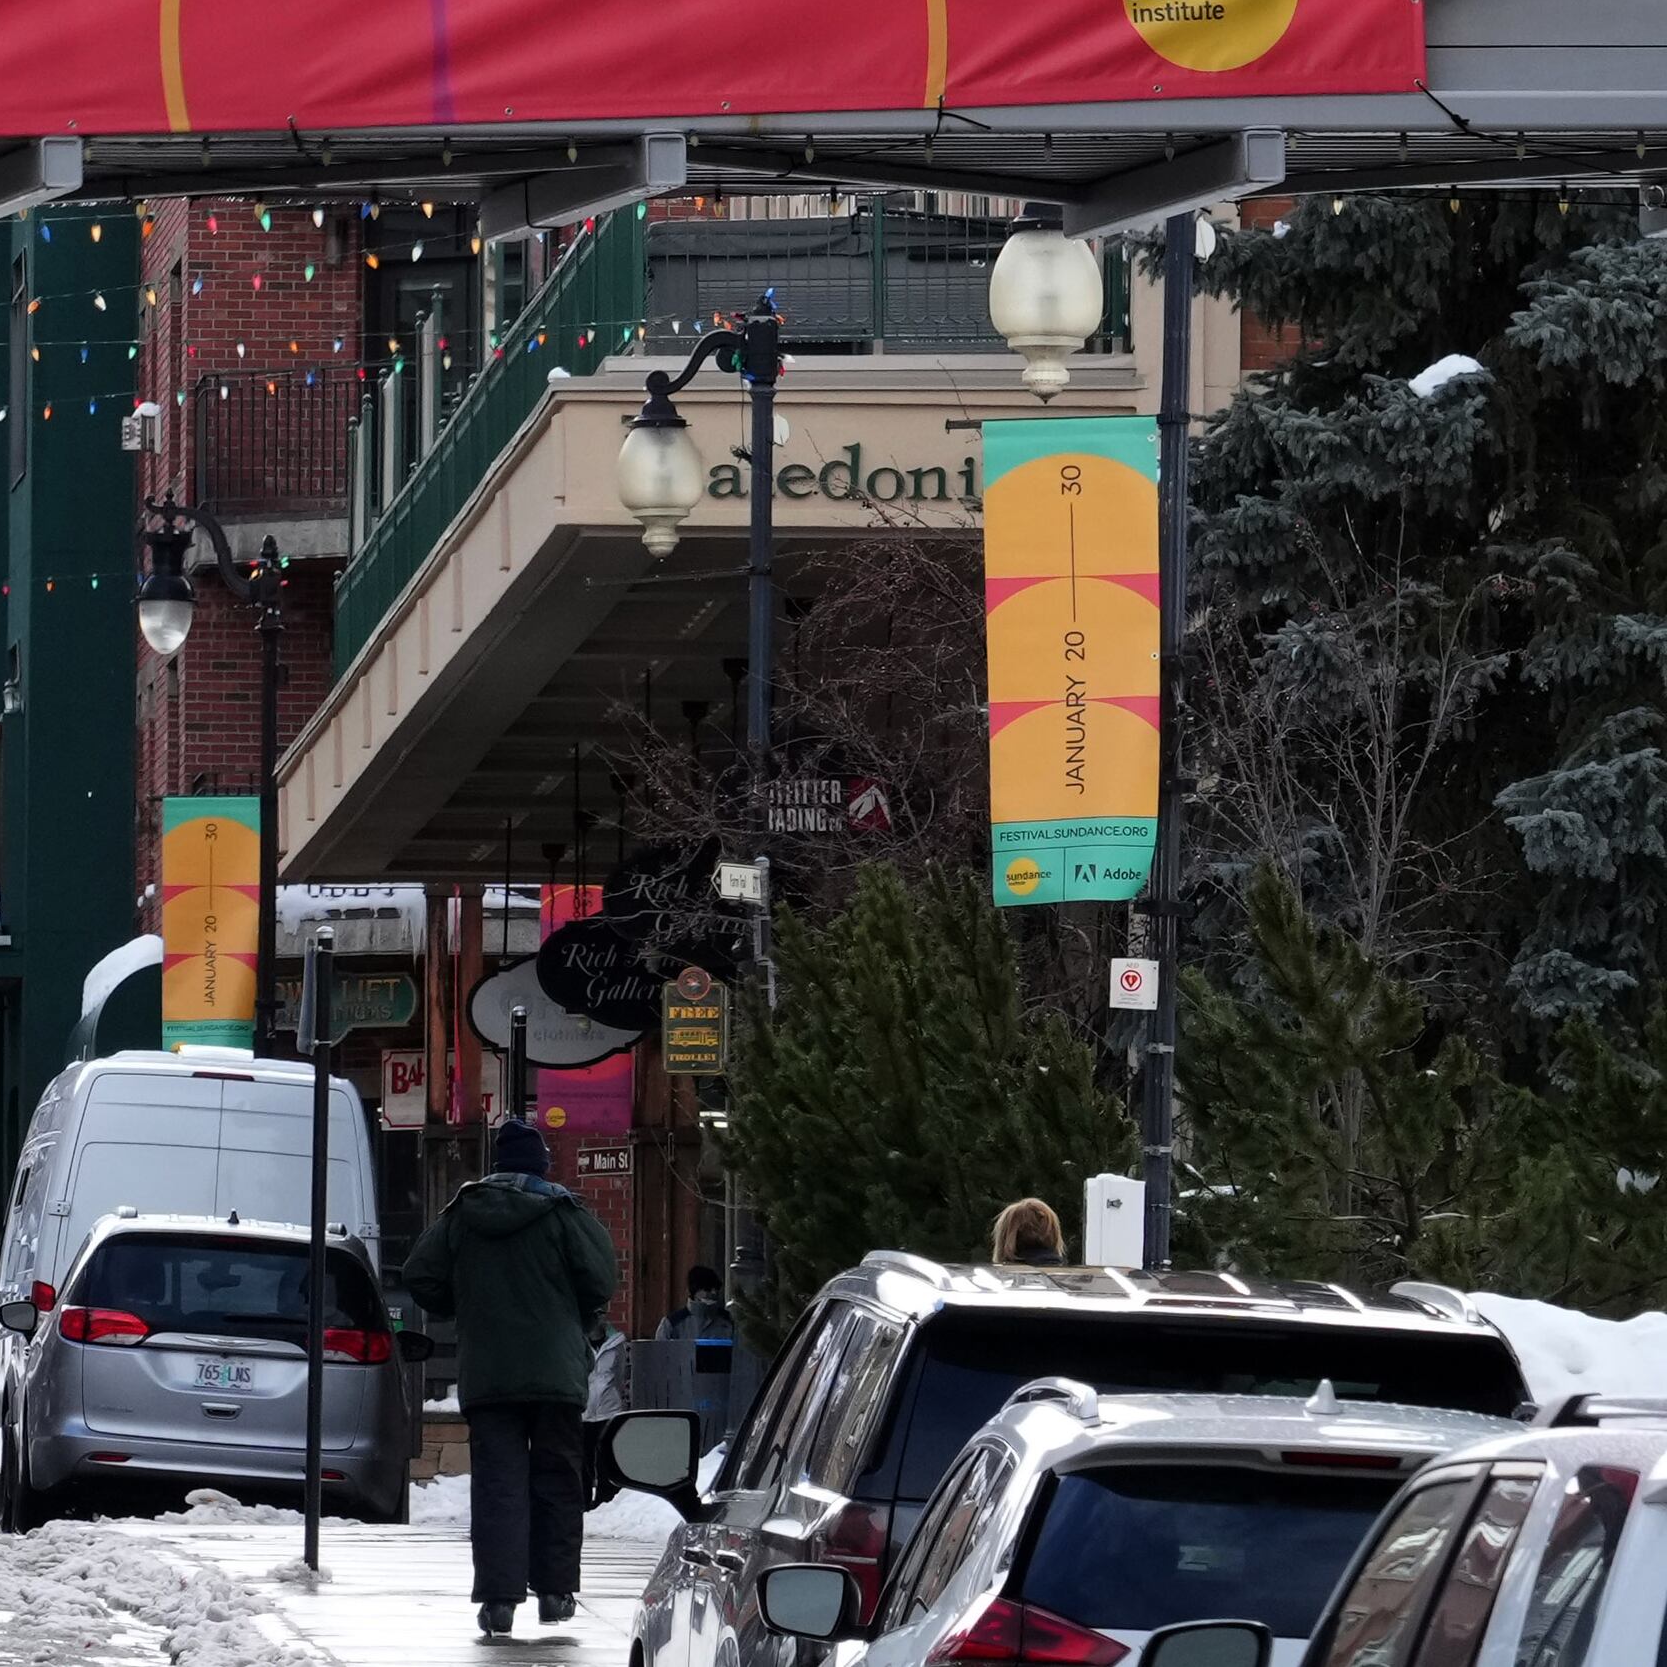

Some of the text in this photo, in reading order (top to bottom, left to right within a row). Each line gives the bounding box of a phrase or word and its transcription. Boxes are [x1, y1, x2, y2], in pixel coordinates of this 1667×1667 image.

[1133, 1, 1224, 24] institute
[708, 443, 981, 501] aedoni
[1060, 464, 1082, 496] 30
[1065, 630, 1086, 662] 20
[1065, 675, 1087, 795] JANUARY
[205, 823, 218, 842] 30
[1000, 826, 1148, 843] FESTIVAL.SUNDANCE.ORG
[1007, 868, 1142, 882] sundance Adobe
[204, 915, 217, 933] 20
[562, 943, 618, 977] Rich
[203, 941, 218, 1007] JANUARY
[587, 970, 661, 1008] Galler
[668, 1006, 720, 1019] FREE
[593, 1151, 629, 1170] Main St
[197, 1363, 251, 1383] 765 LNS
